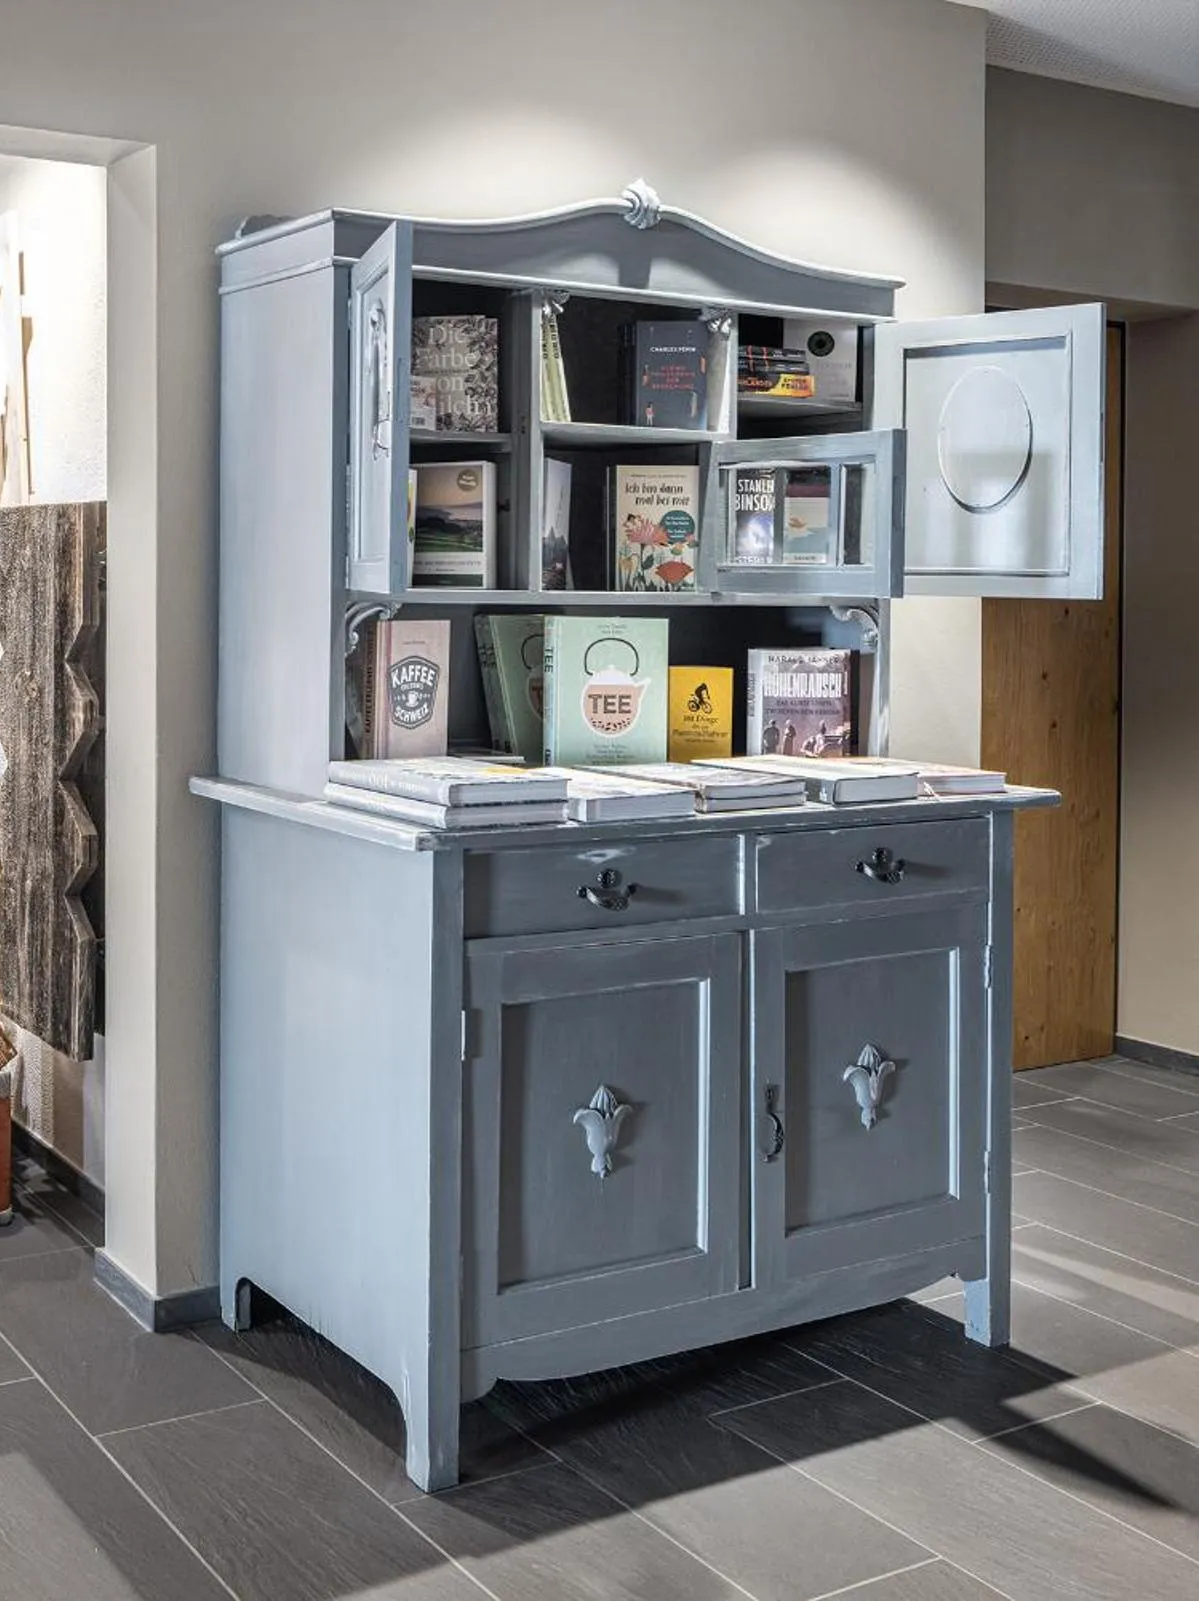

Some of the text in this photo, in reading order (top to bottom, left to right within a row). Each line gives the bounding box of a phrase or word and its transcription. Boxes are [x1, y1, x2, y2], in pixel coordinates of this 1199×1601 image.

[428, 325, 478, 344] Die
[415, 347, 478, 369] Farbe
[438, 376, 464, 391] on
[625, 483, 640, 494] Ich
[738, 480, 774, 493] STANLE
[735, 494, 776, 512] BINSO
[544, 648, 554, 673] TEE
[391, 665, 435, 688] KAFFEE
[394, 702, 429, 723] SCHWEIZ
[588, 694, 631, 714] TEE
